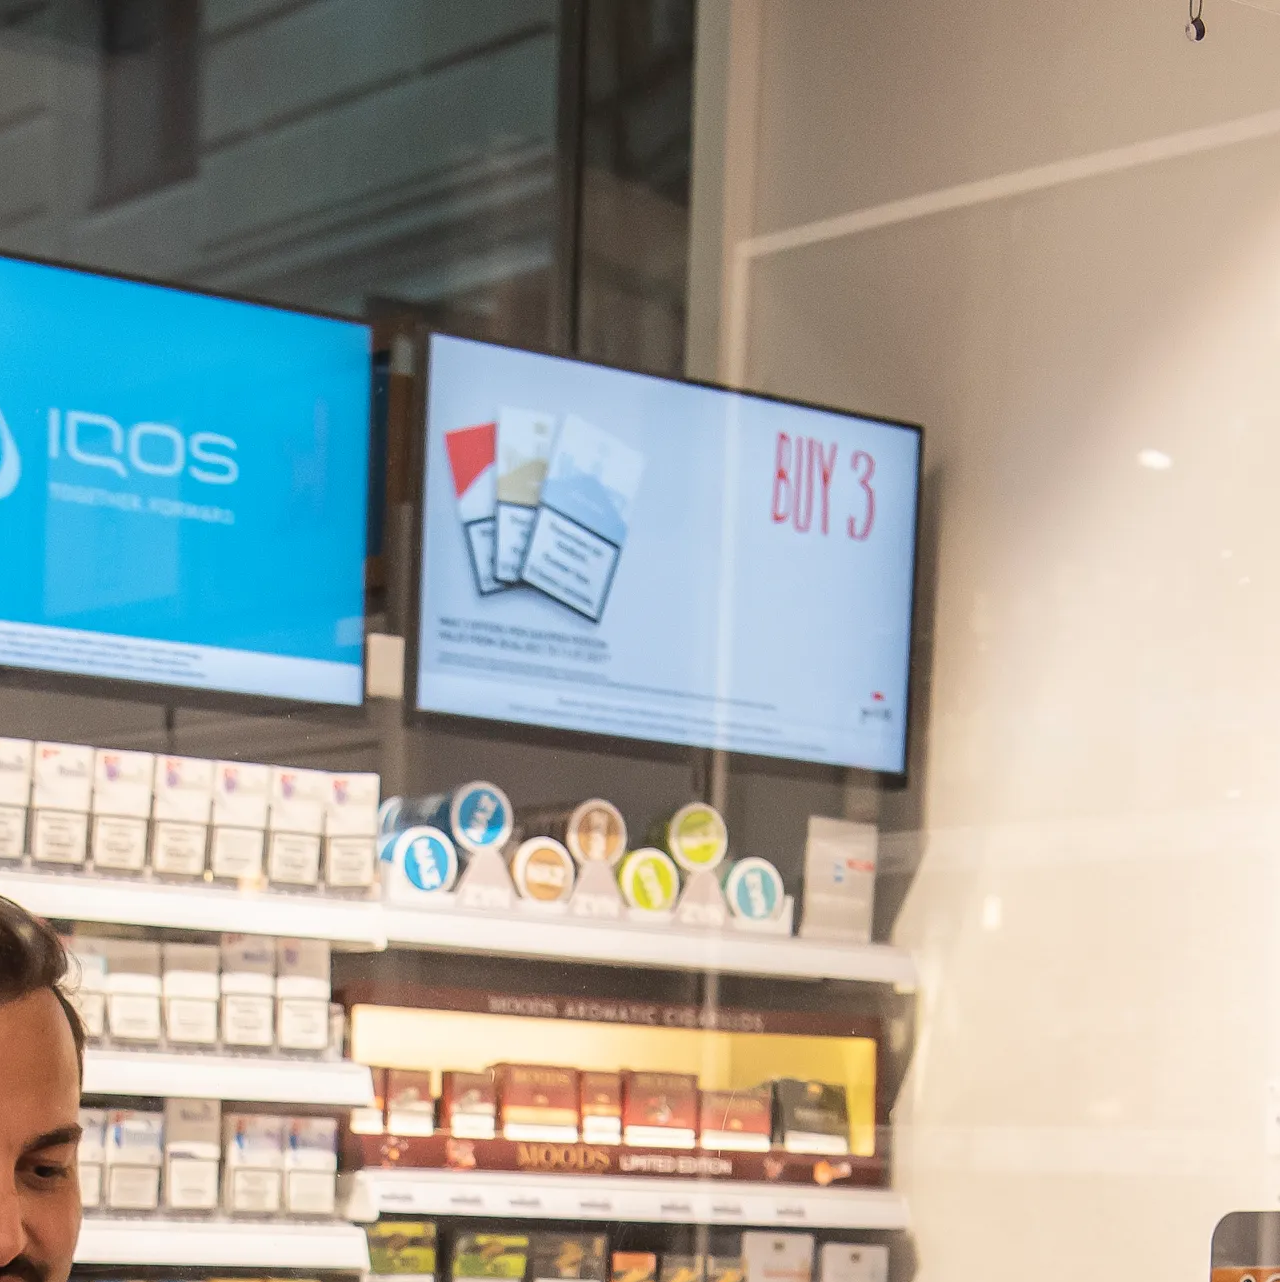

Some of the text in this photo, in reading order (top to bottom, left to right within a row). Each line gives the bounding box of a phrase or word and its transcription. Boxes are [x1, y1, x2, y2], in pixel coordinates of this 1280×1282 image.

[47, 407, 239, 485] IQOS
[771, 431, 877, 542] BUY 3
